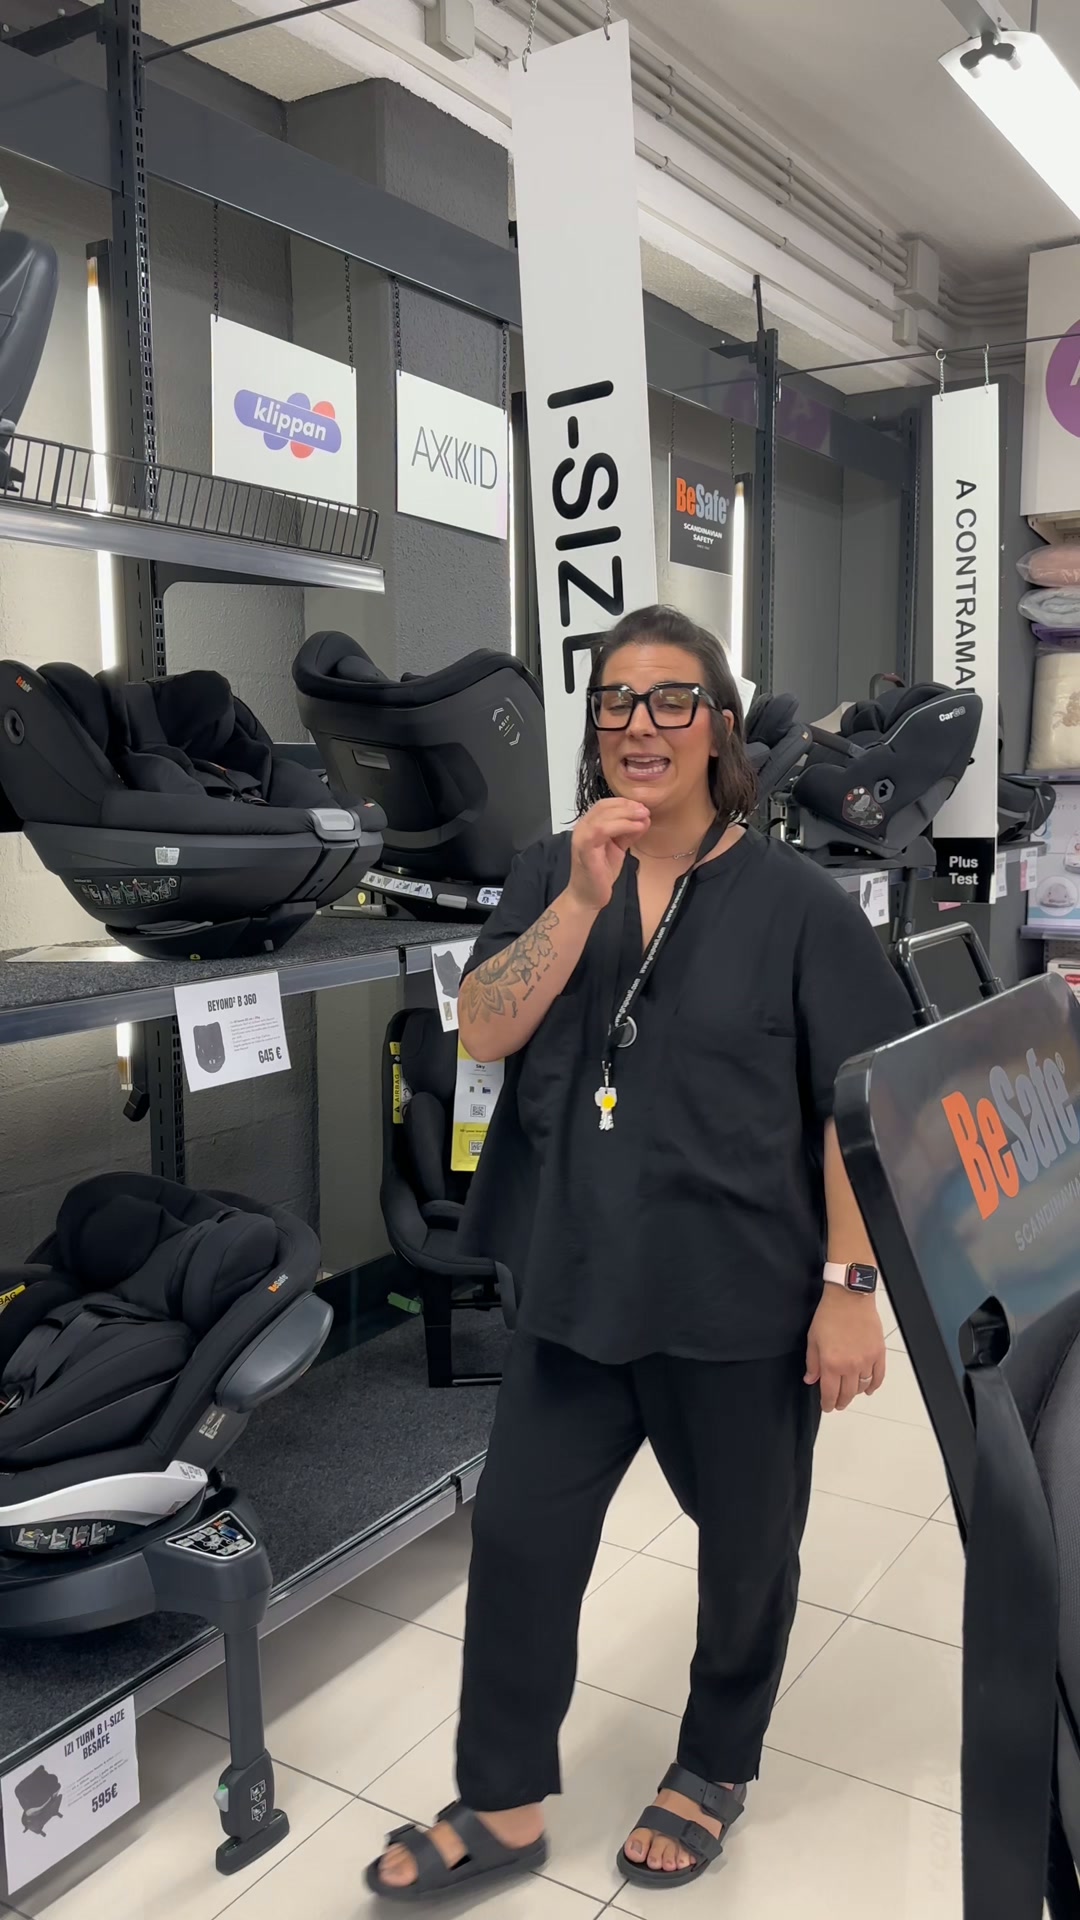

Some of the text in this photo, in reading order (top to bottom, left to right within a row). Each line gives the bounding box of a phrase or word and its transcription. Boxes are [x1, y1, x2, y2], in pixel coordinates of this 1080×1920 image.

[253, 397, 327, 441] klippan
[683, 523, 722, 539] SCANDINAVIAN
[693, 533, 714, 545] SAFETY
[956, 479, 977, 693] A CONTRAMA
[949, 856, 978, 868] Plus
[949, 872, 978, 885] Test
[237, 995, 243, 1007] B
[243, 993, 257, 1006] 360
[258, 1048, 274, 1064] 645
[64, 1708, 125, 1757] IZI TURN B I-SIZE
[82, 1733, 110, 1760] BESAFE
[91, 1783, 118, 1813] 595€
